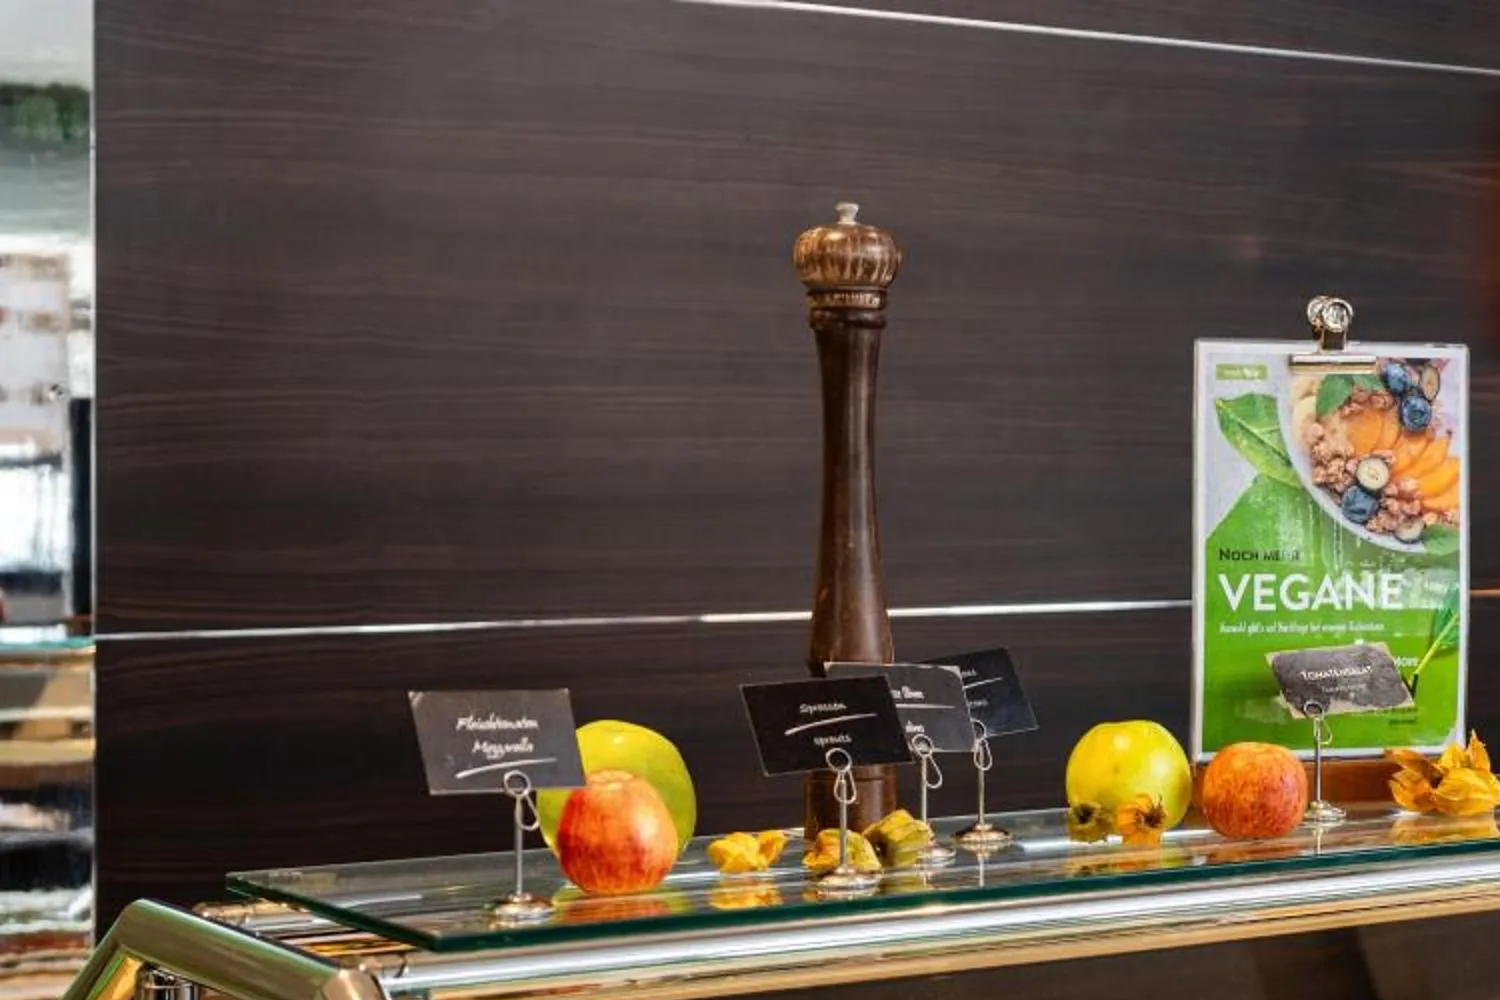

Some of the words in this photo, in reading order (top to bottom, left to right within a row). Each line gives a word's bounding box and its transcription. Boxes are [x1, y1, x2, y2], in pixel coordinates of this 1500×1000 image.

[1219, 548, 1259, 561] NOCH
[1218, 573, 1405, 611] VEGANE
[813, 734, 852, 747] sprouts
